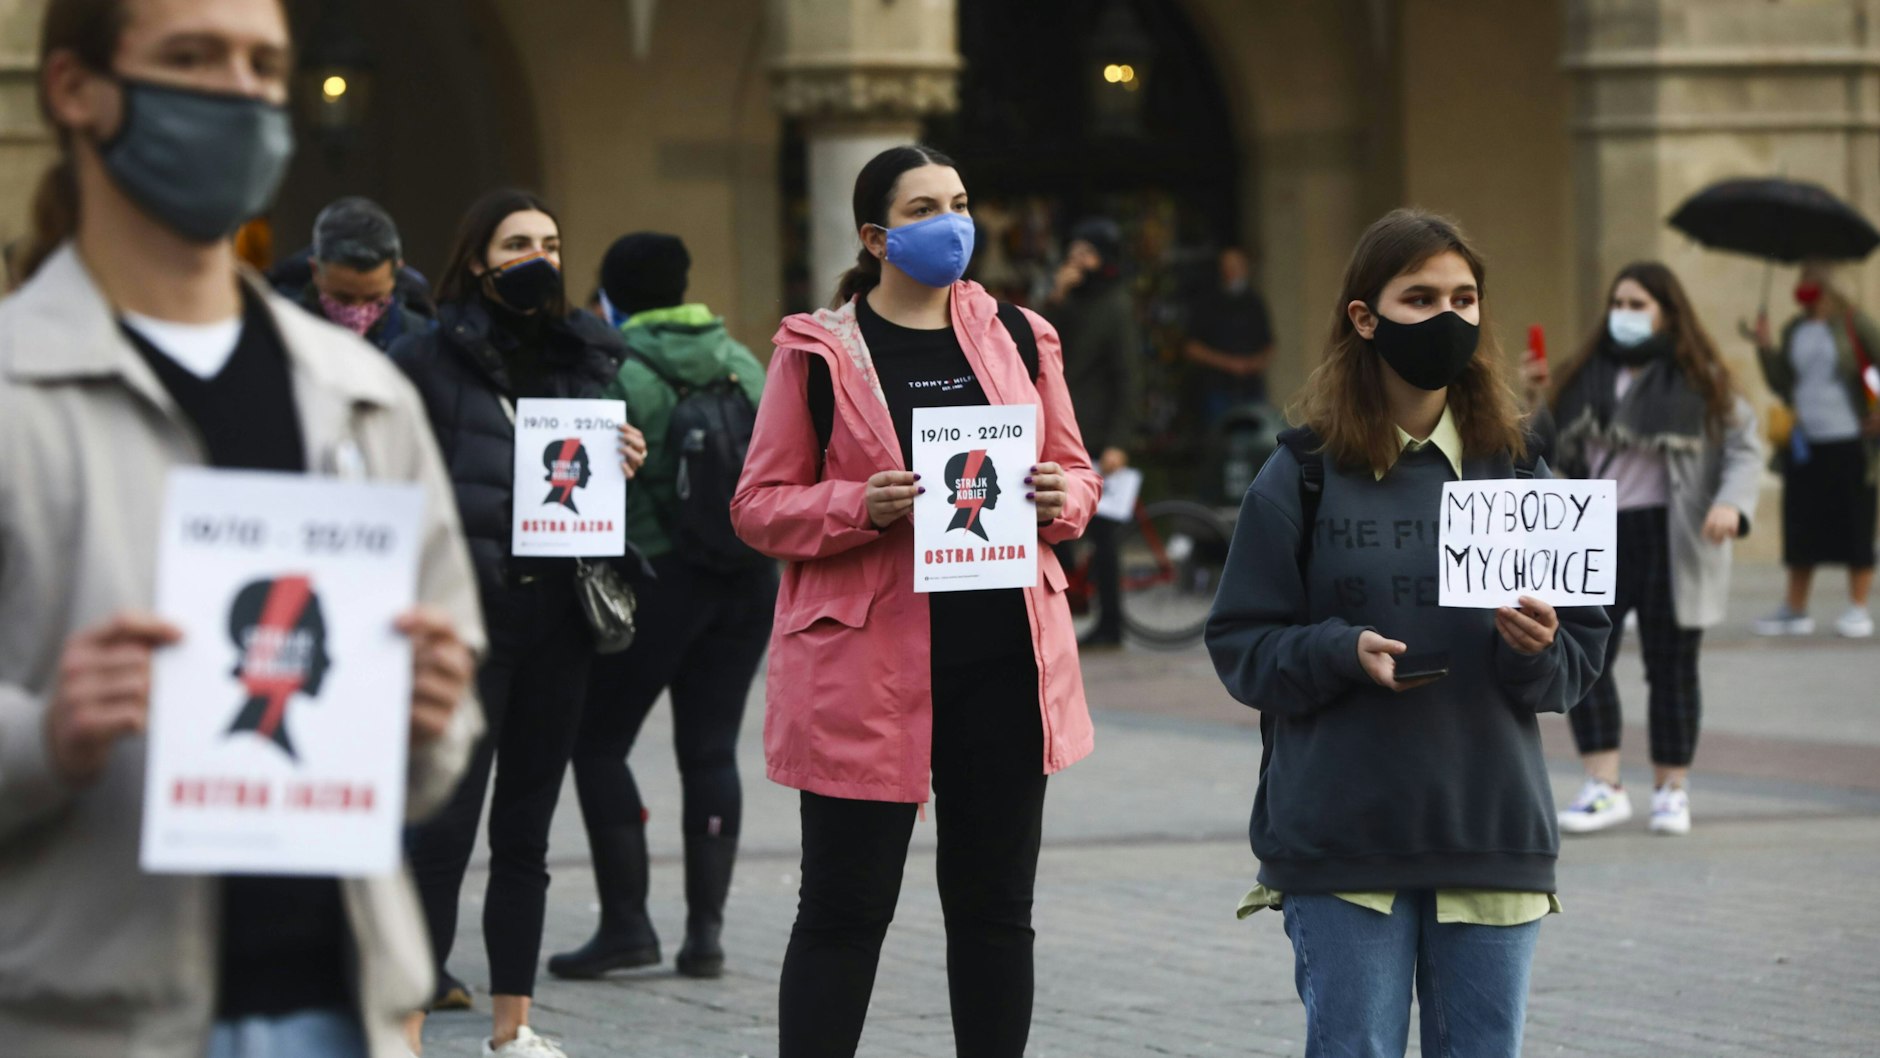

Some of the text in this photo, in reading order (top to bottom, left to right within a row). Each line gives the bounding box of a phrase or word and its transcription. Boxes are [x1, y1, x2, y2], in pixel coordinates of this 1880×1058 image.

[908, 380, 942, 388] TOMMY
[523, 416, 559, 429] 19/10
[573, 417, 616, 431] 22/10
[921, 427, 961, 443] 19/10
[978, 424, 1023, 442] 22/10
[955, 477, 988, 489] STRAJK
[956, 488, 987, 500] KOBIET
[521, 520, 614, 532] OSTRA JAZDA
[924, 545, 1026, 565] OSTRA JAZDA
